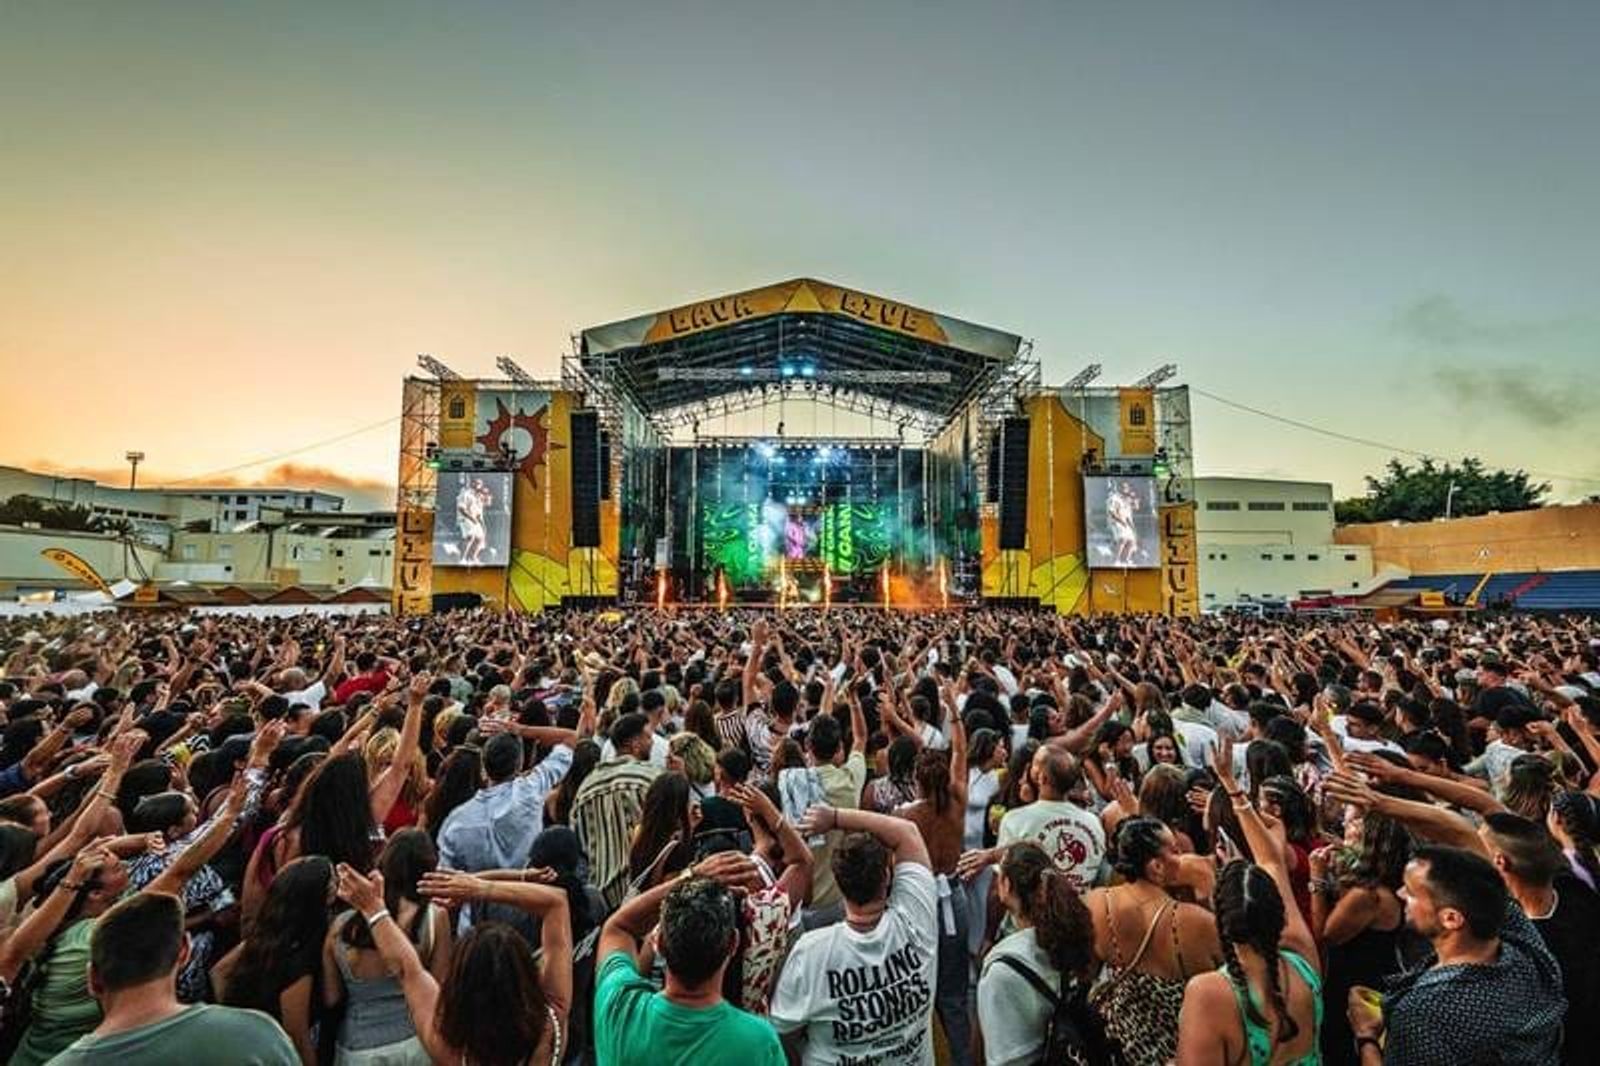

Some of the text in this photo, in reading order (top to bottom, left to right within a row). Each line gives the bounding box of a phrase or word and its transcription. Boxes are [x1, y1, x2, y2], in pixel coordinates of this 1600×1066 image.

[840, 291, 921, 333] LIVE
[826, 943, 922, 1000] ROLLING
[838, 971, 930, 1022] STONES
